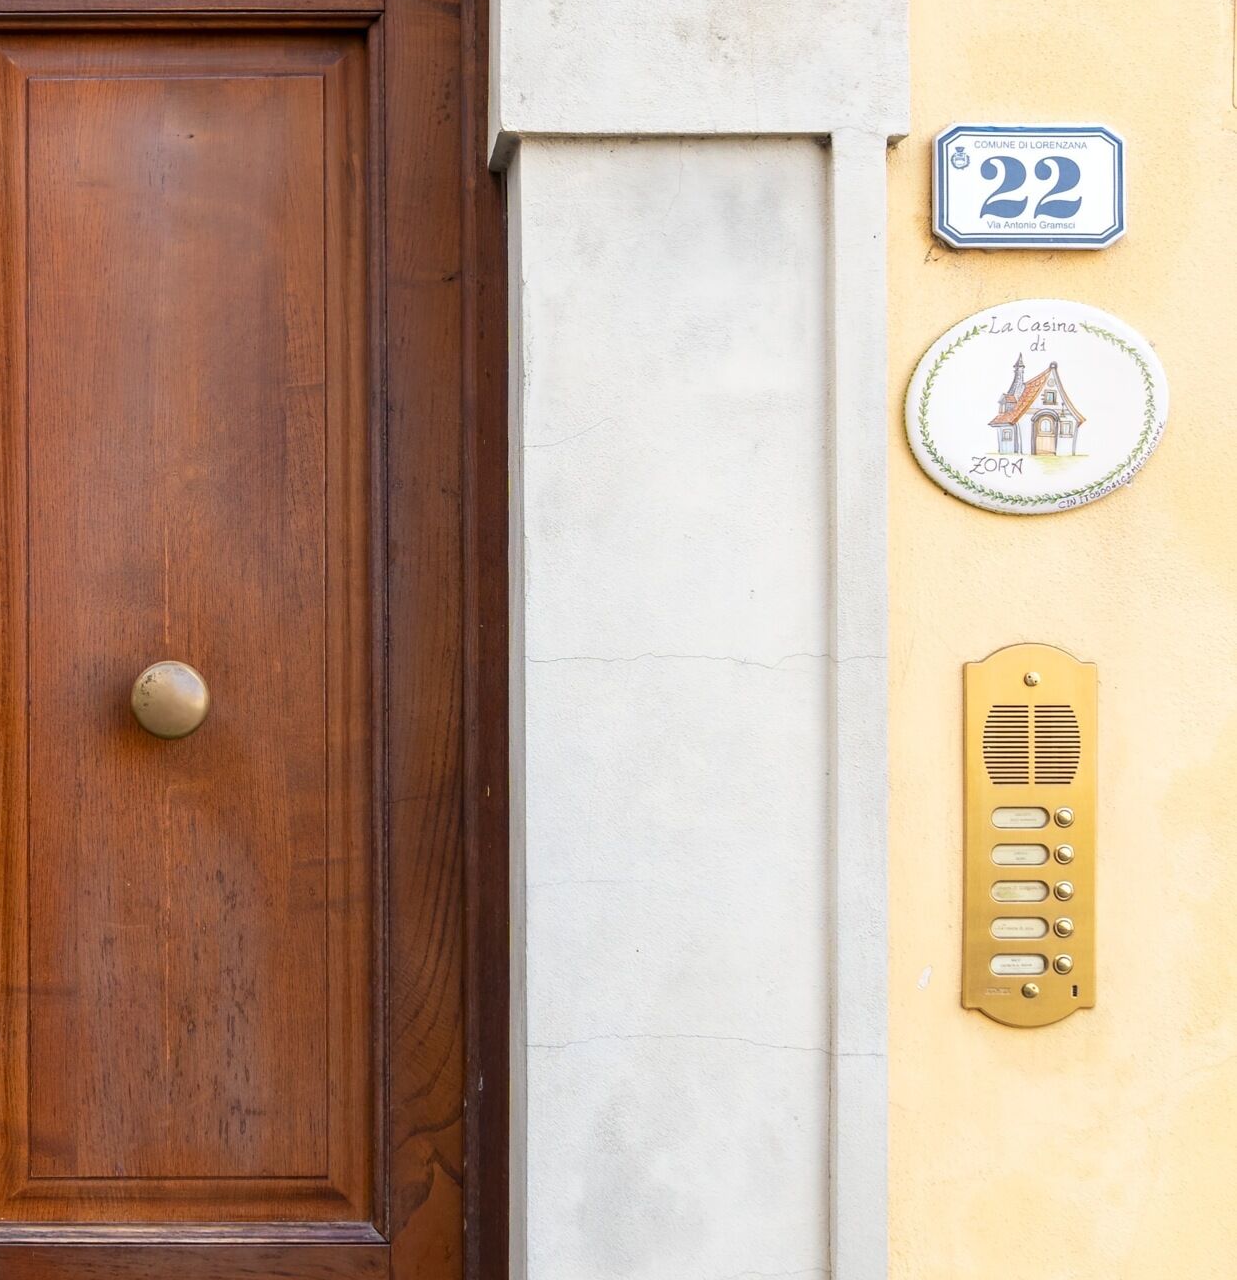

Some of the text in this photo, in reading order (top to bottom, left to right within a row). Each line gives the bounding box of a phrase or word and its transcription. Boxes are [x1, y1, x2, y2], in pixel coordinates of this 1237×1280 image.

[974, 140, 1088, 149] COMUNE DI LORENZANA
[979, 155, 1082, 219] 22
[987, 221, 1076, 229] Via Antonio Gramsci
[988, 315, 1078, 334] La Casina
[1030, 335, 1047, 352] di
[969, 456, 1024, 477] ZORA
